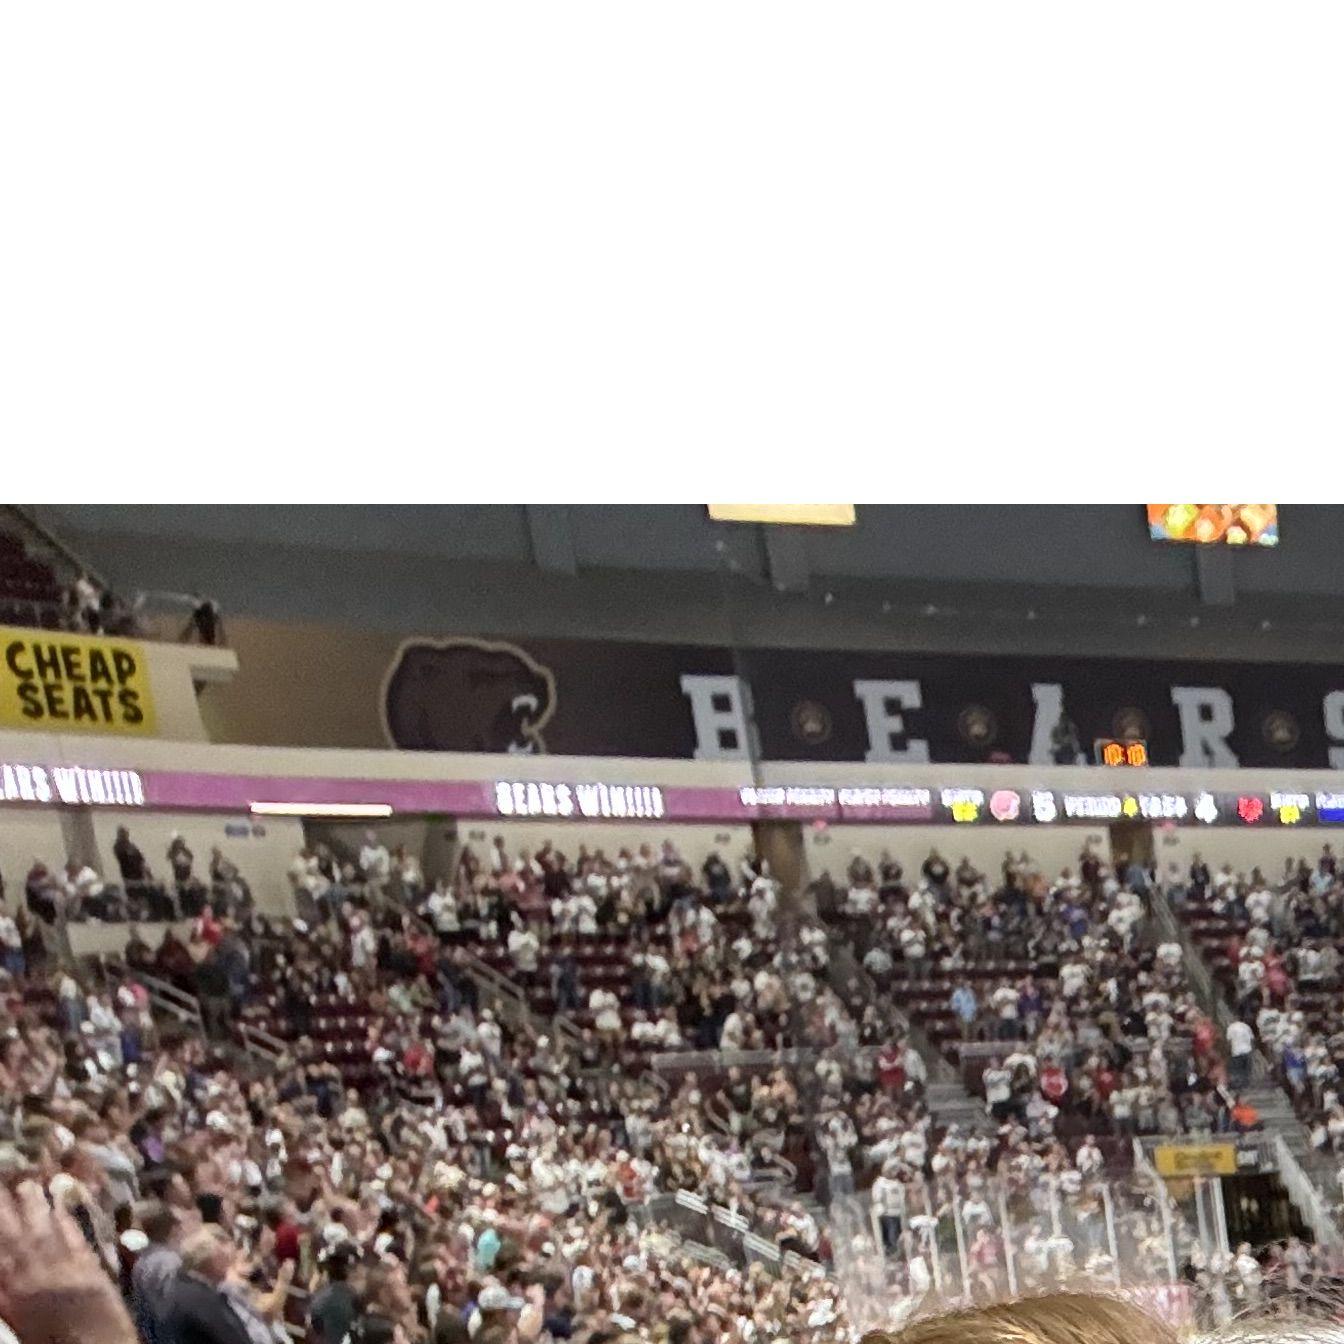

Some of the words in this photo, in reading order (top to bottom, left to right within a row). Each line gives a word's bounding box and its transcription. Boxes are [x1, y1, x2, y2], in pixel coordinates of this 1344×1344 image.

[6, 641, 136, 684] CHEAP
[17, 682, 144, 724] SEATS
[495, 781, 574, 816] BEARS
